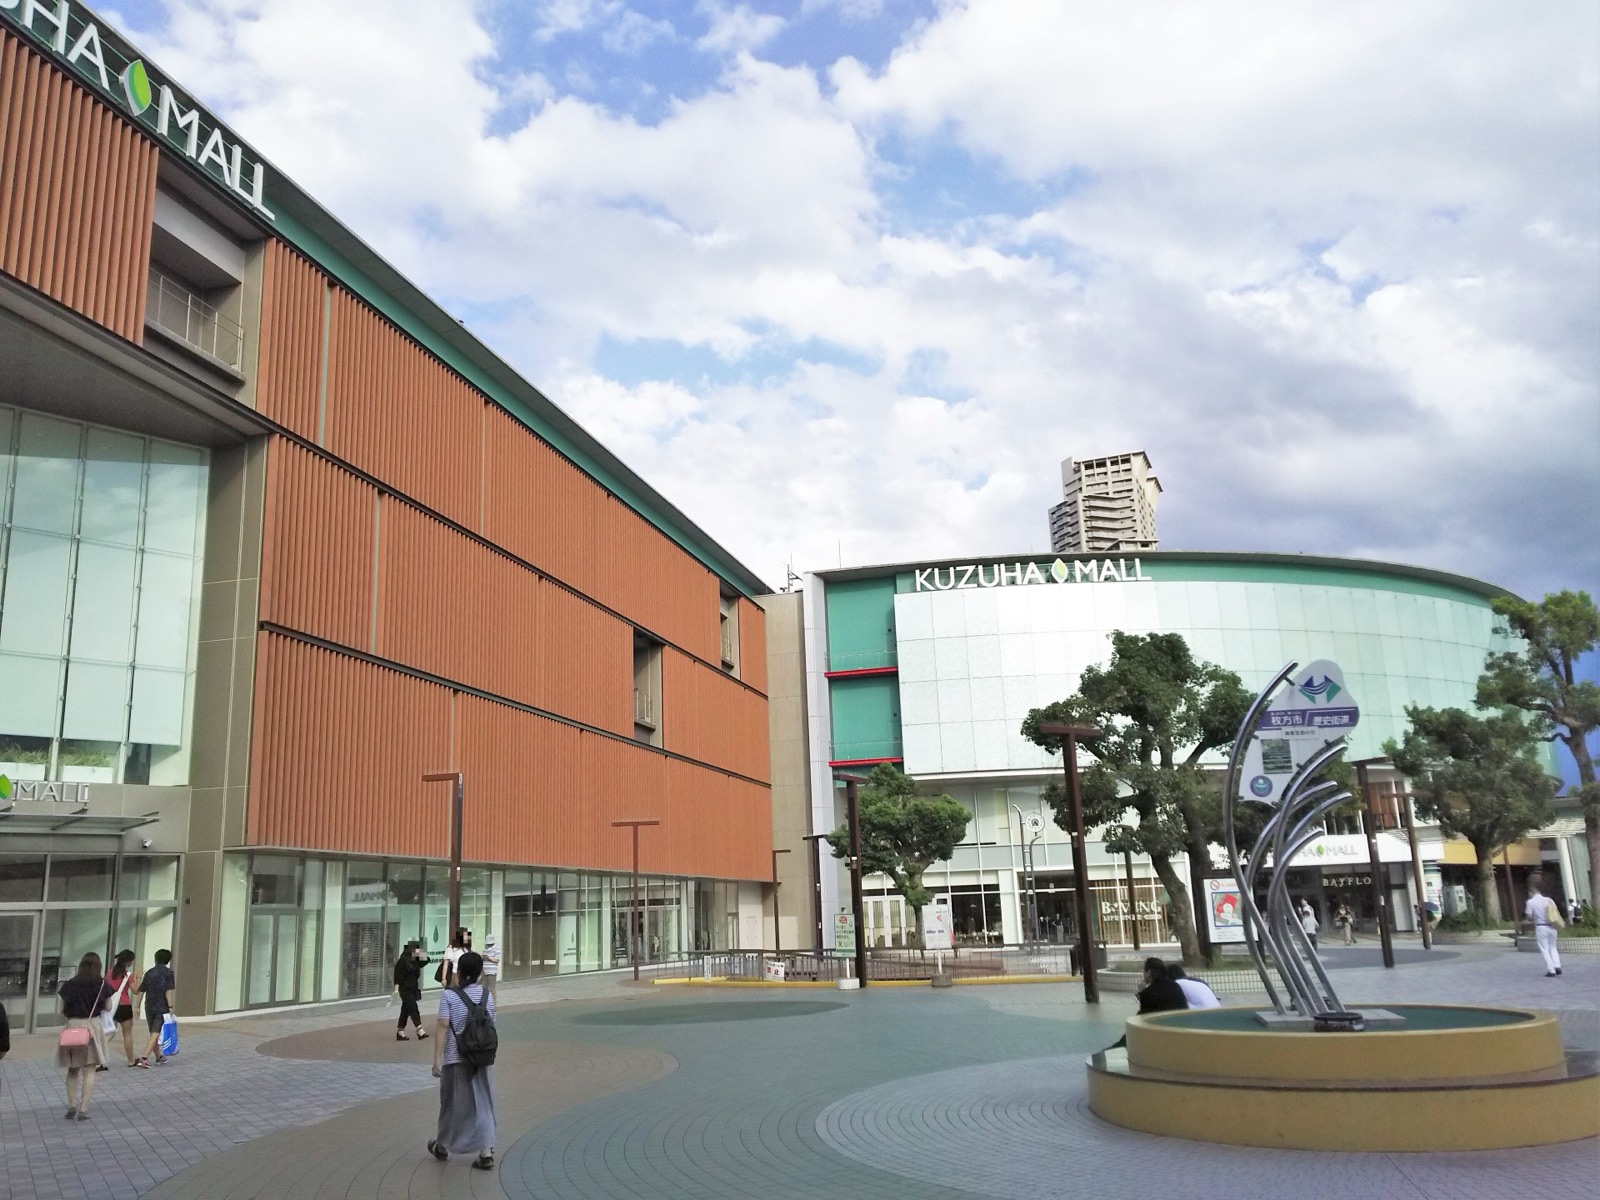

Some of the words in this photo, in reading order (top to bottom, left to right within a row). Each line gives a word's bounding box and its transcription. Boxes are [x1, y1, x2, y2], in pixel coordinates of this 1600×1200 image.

[157, 84, 275, 222] MALL
[915, 561, 1046, 592] KUZUHA
[1074, 558, 1152, 583] MALL
[16, 780, 90, 803] MALL
[1325, 845, 1359, 856] MALL
